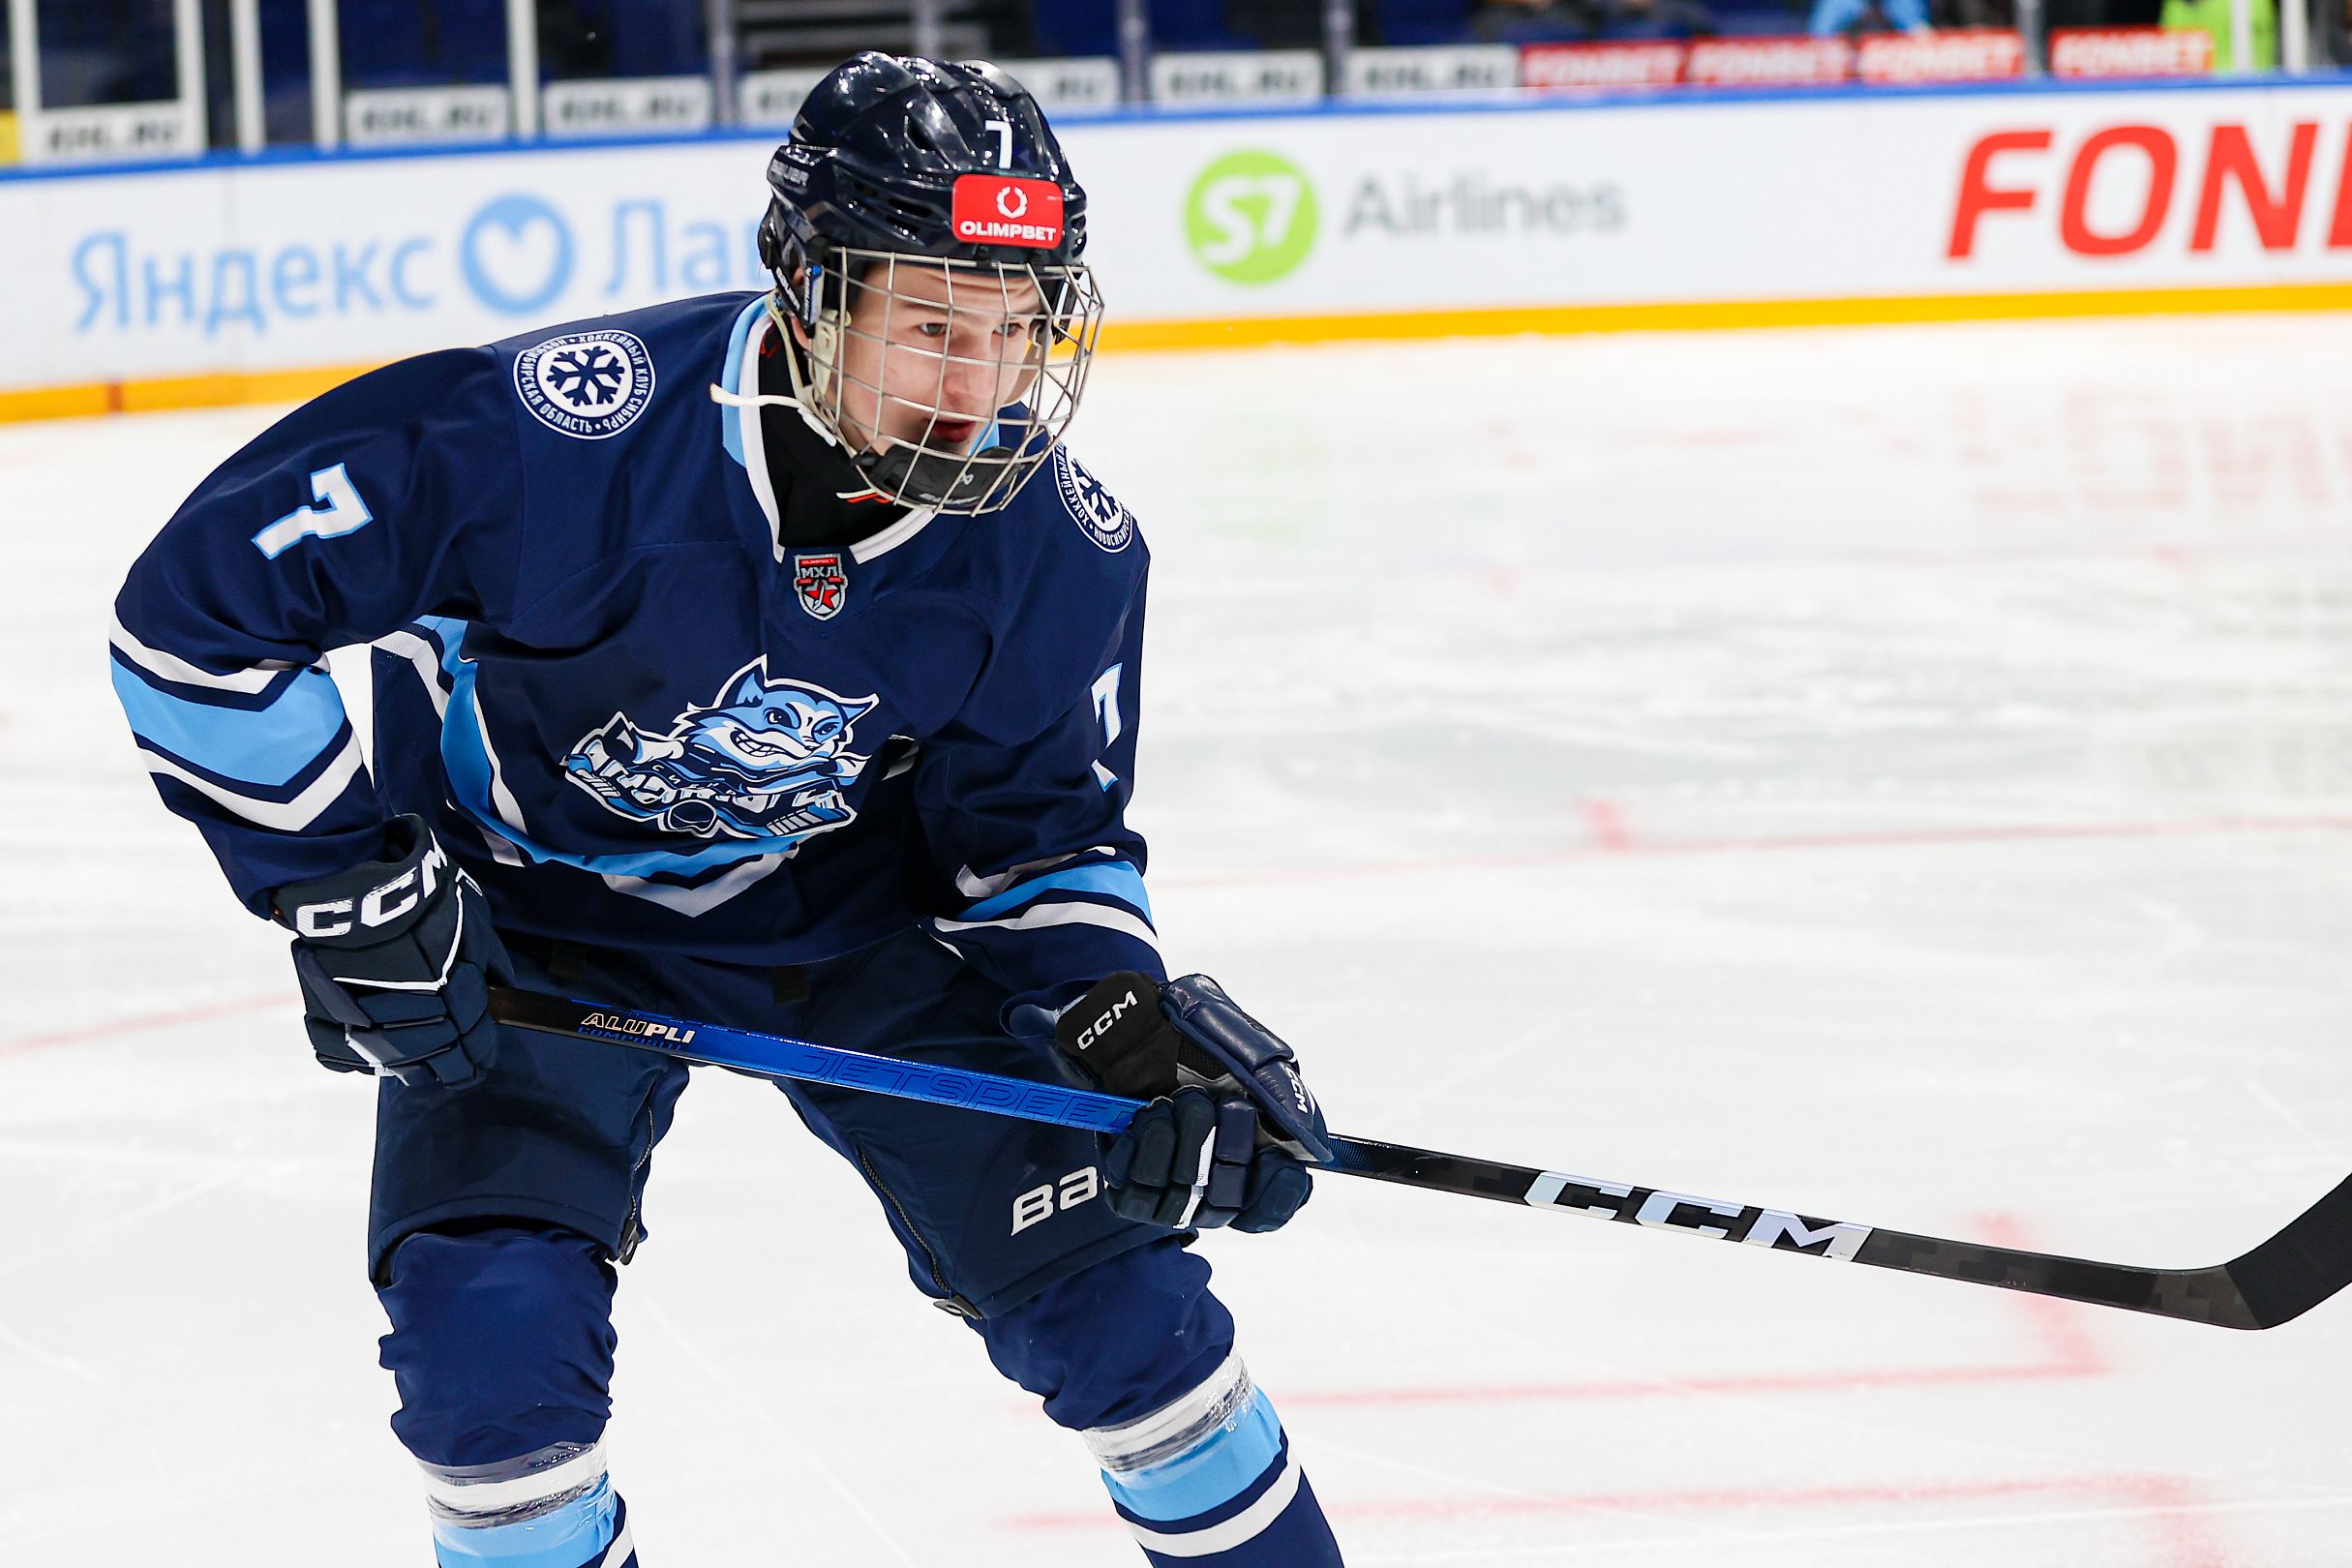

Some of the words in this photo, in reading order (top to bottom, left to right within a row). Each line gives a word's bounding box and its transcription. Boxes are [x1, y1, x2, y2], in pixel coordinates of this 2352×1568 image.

[985, 120, 1013, 169] 7
[1201, 174, 1302, 265] S7
[1344, 174, 1628, 235] Airlines
[1944, 120, 2352, 259] FON
[960, 221, 1057, 241] OLIMPBET
[72, 232, 436, 334] Яндекс
[602, 196, 761, 294] Ла
[634, 368, 649, 396] КЛУБ
[538, 403, 593, 434] ОБЛАСТЬ
[602, 398, 644, 432] СИБИРЬ
[250, 462, 375, 561] 7
[801, 566, 838, 578] МХЛ
[1090, 662, 1124, 794] 7
[296, 827, 448, 938] CCM
[581, 1012, 696, 1043] ALUPLI
[1076, 990, 1138, 1050] CCM
[1284, 1066, 1309, 1114] CCM
[1010, 1165, 1109, 1236] Ba
[1523, 1171, 1873, 1262] CCM
